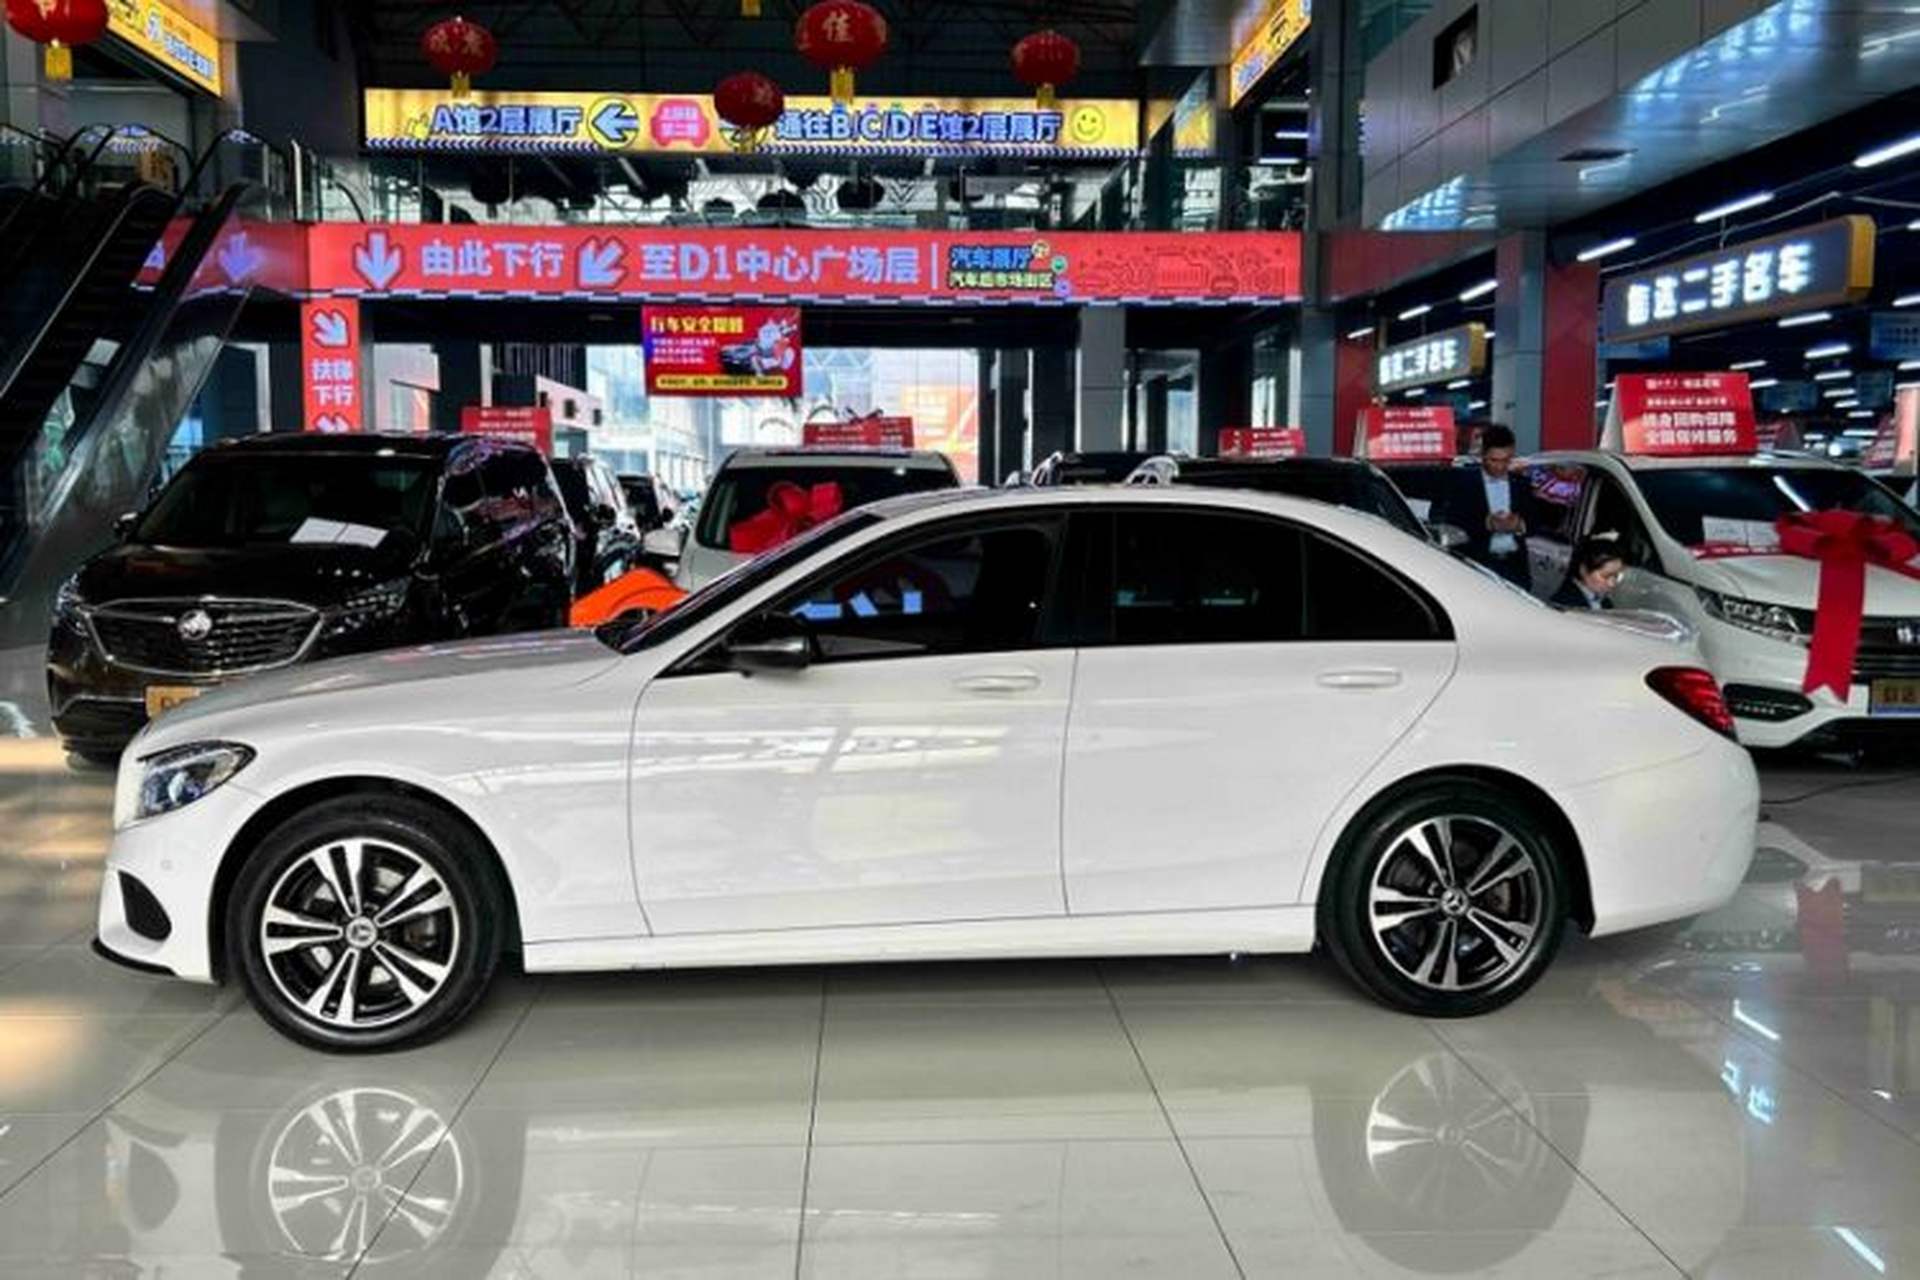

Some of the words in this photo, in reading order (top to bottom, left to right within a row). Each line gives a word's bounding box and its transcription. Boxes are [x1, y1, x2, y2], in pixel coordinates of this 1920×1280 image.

[433, 105, 583, 137] A馆2层展厅
[421, 239, 565, 278] 由此下行
[640, 243, 920, 284] 至D1中心广场层
[312, 385, 353, 405] 下行
